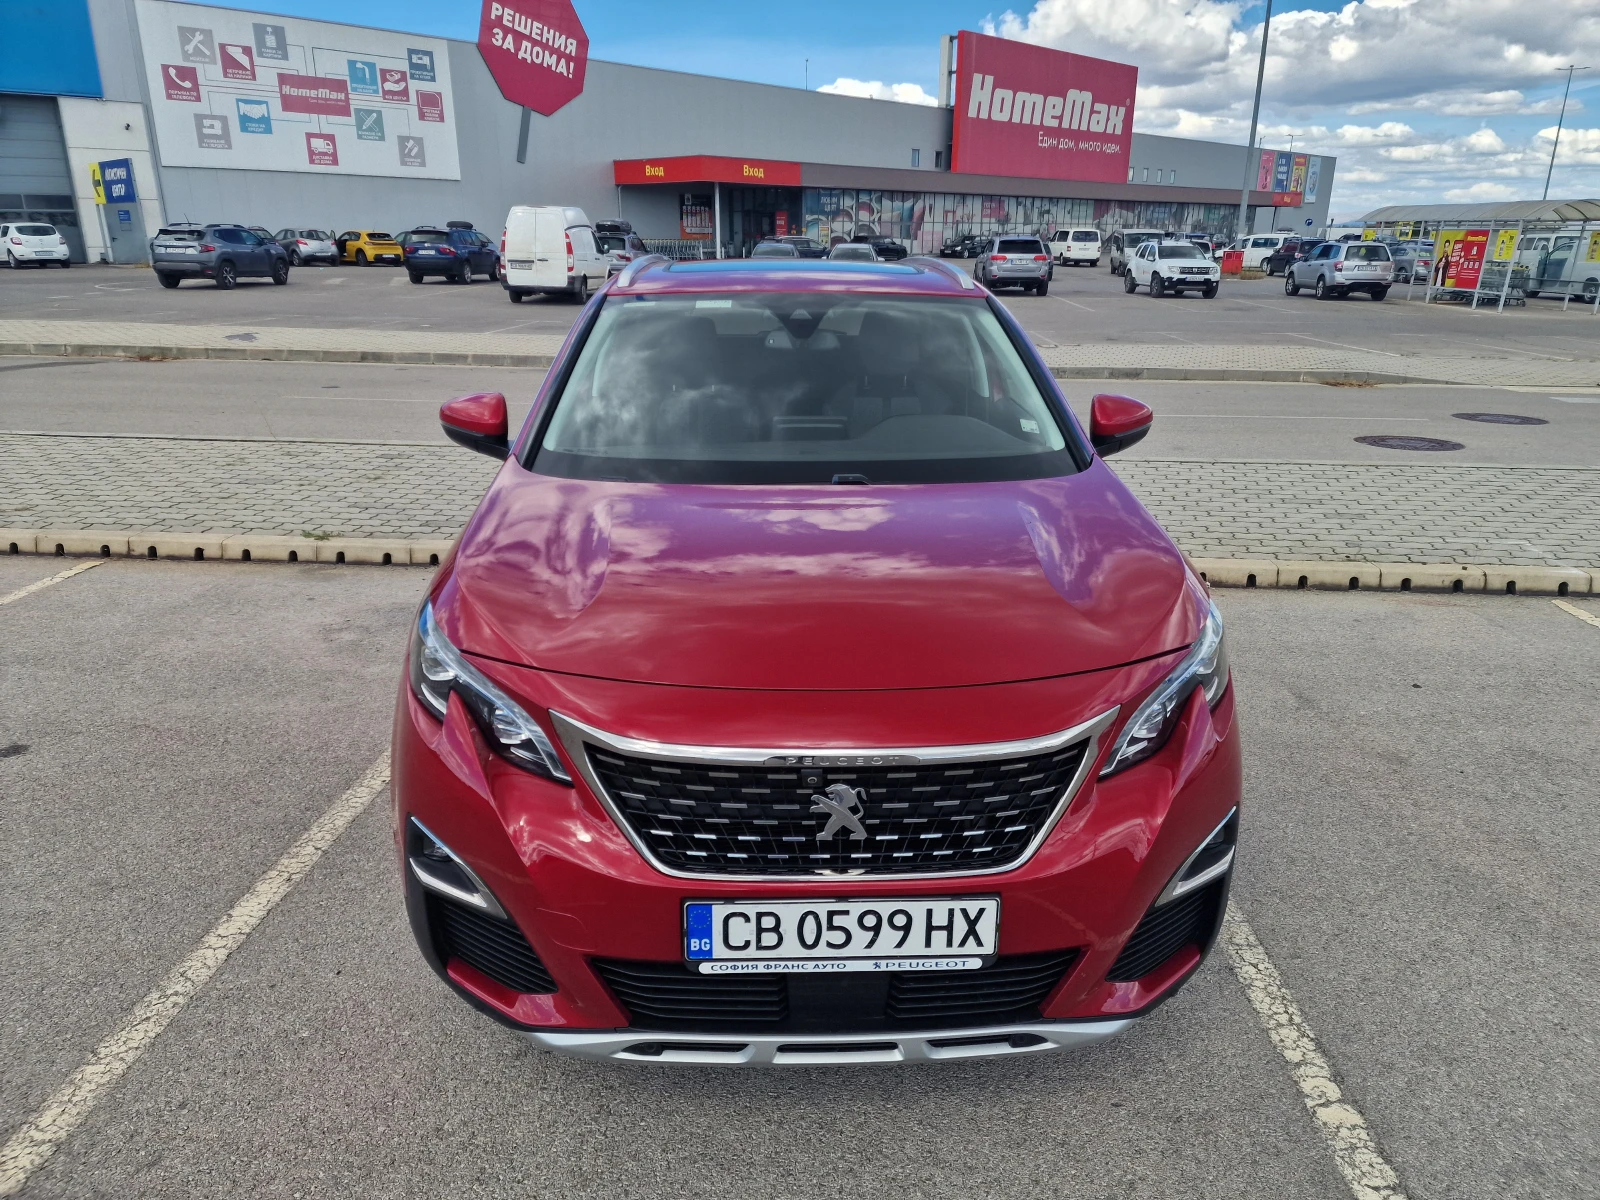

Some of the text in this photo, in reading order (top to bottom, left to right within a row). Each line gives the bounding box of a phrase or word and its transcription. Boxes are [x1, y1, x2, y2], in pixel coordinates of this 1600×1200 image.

[491, 2, 577, 57] РЕШЕНИЯ
[491, 28, 575, 79] ЗА ДОМА!
[281, 84, 346, 100] HomeMax
[967, 72, 1126, 135] HomeMax
[1038, 131, 1121, 154] Един дом, много идеи.
[645, 164, 665, 177] Вход
[743, 164, 765, 179] Вход
[787, 756, 900, 767] PEUGEOT
[722, 907, 987, 952] CB 0599 HX
[690, 938, 711, 951] BG
[710, 962, 847, 972] СОФИЯ ФРАНС АУТО
[885, 960, 970, 969] PEUGEOT
